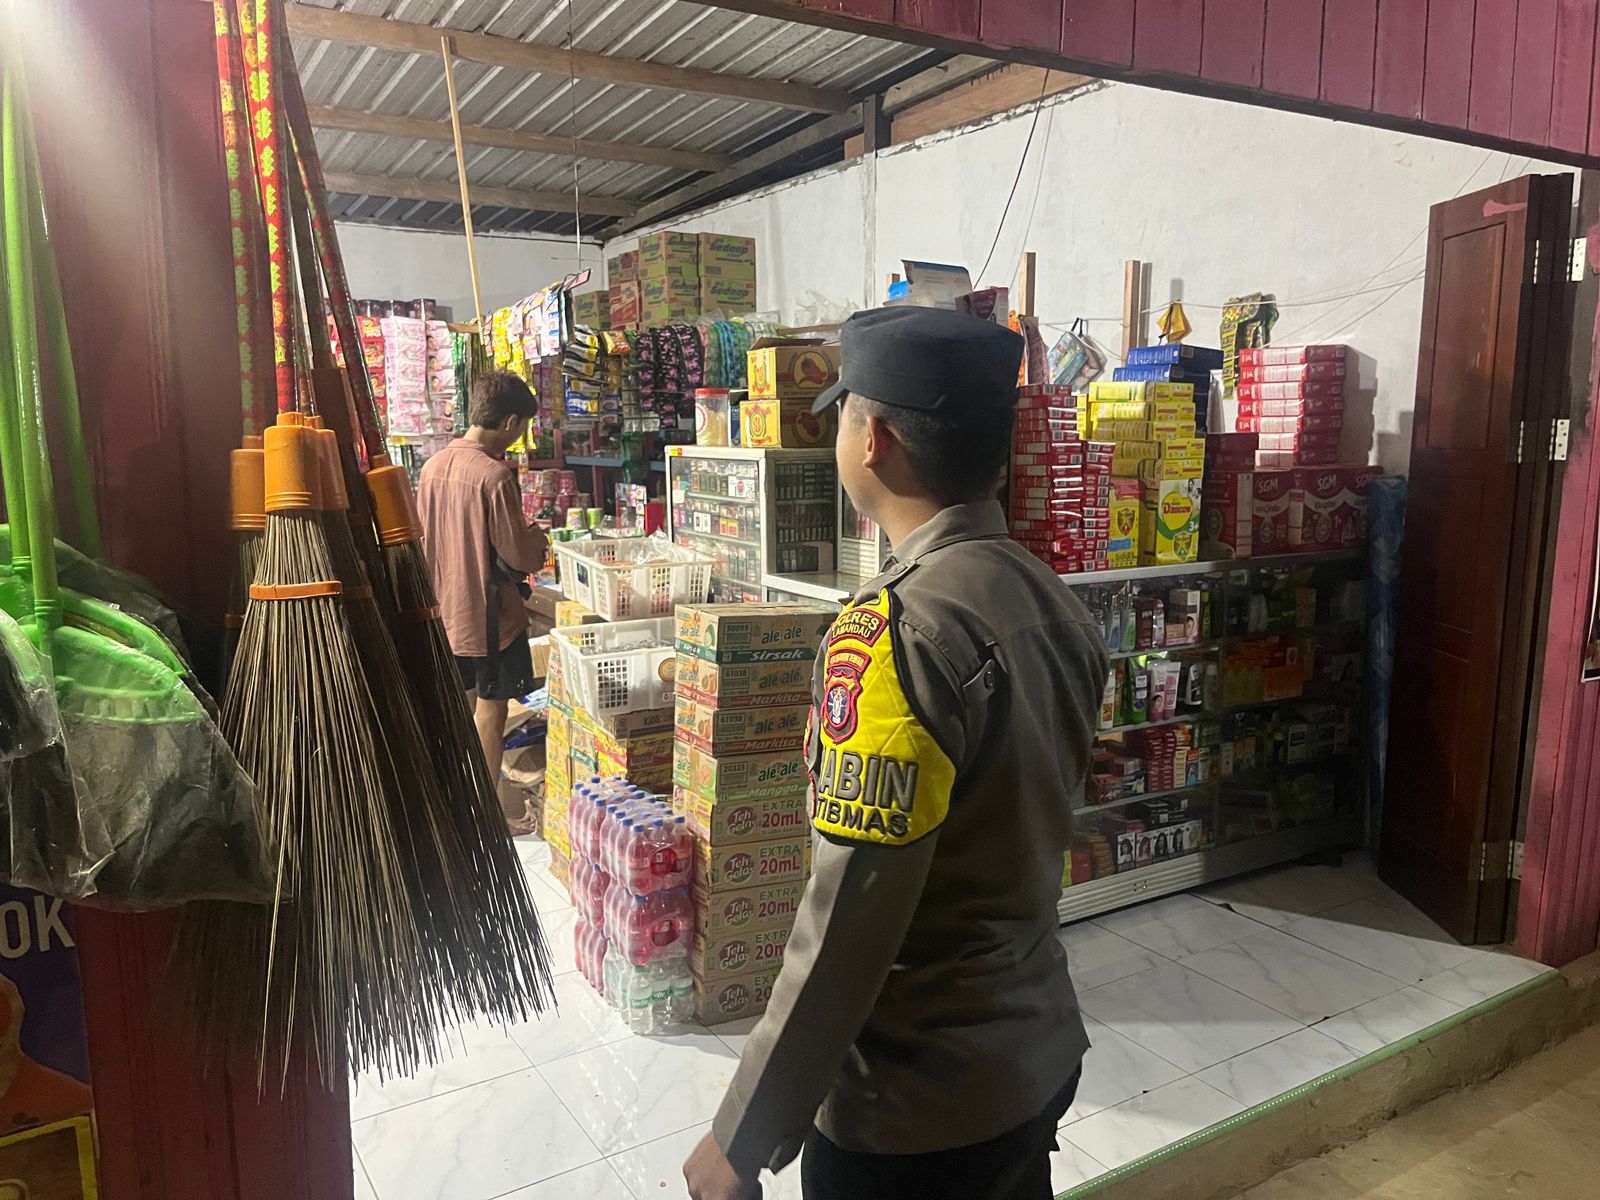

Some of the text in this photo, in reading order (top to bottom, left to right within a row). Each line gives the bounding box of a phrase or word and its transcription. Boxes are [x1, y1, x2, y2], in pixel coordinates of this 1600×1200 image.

[1259, 478, 1278, 493] SGM
[1317, 474, 1336, 491] SGM
[1189, 522, 1199, 532] 3+
[750, 694, 800, 705] Markisa
[744, 739, 797, 750] Markisa
[748, 785, 798, 798] Mangga
[762, 800, 802, 812] EXTRA
[762, 810, 802, 828] 20mL
[760, 845, 800, 857] EXTRA
[760, 856, 800, 874] 20mL
[760, 888, 799, 900] EXTRA
[720, 952, 750, 970] Gelas
